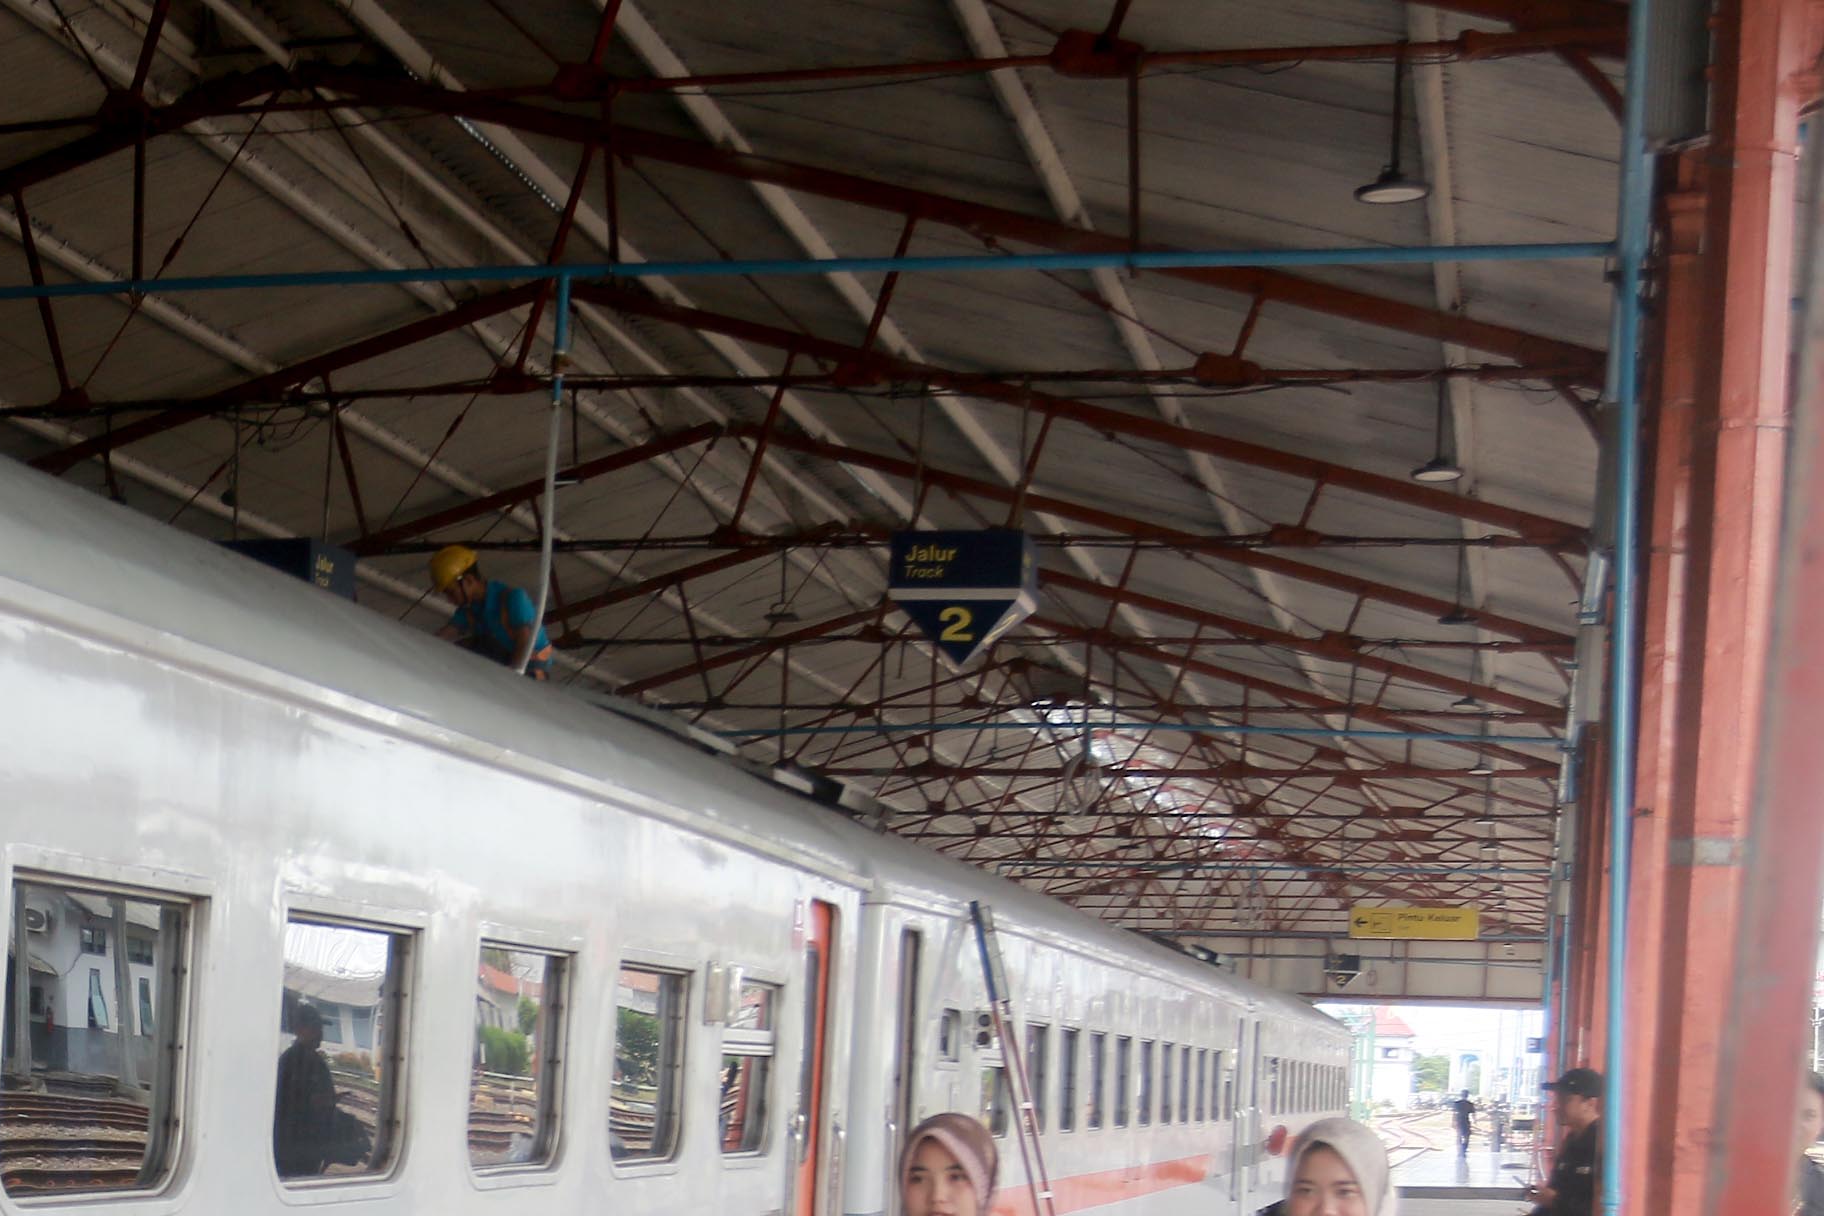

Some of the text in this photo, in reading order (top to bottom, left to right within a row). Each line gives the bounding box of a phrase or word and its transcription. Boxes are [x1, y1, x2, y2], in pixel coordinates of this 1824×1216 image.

[905, 544, 957, 562] Jalur
[904, 565, 946, 579] Track
[938, 606, 975, 642] 2
[1397, 913, 1462, 922] Pintu Keluar
[1336, 975, 1346, 985] 2
